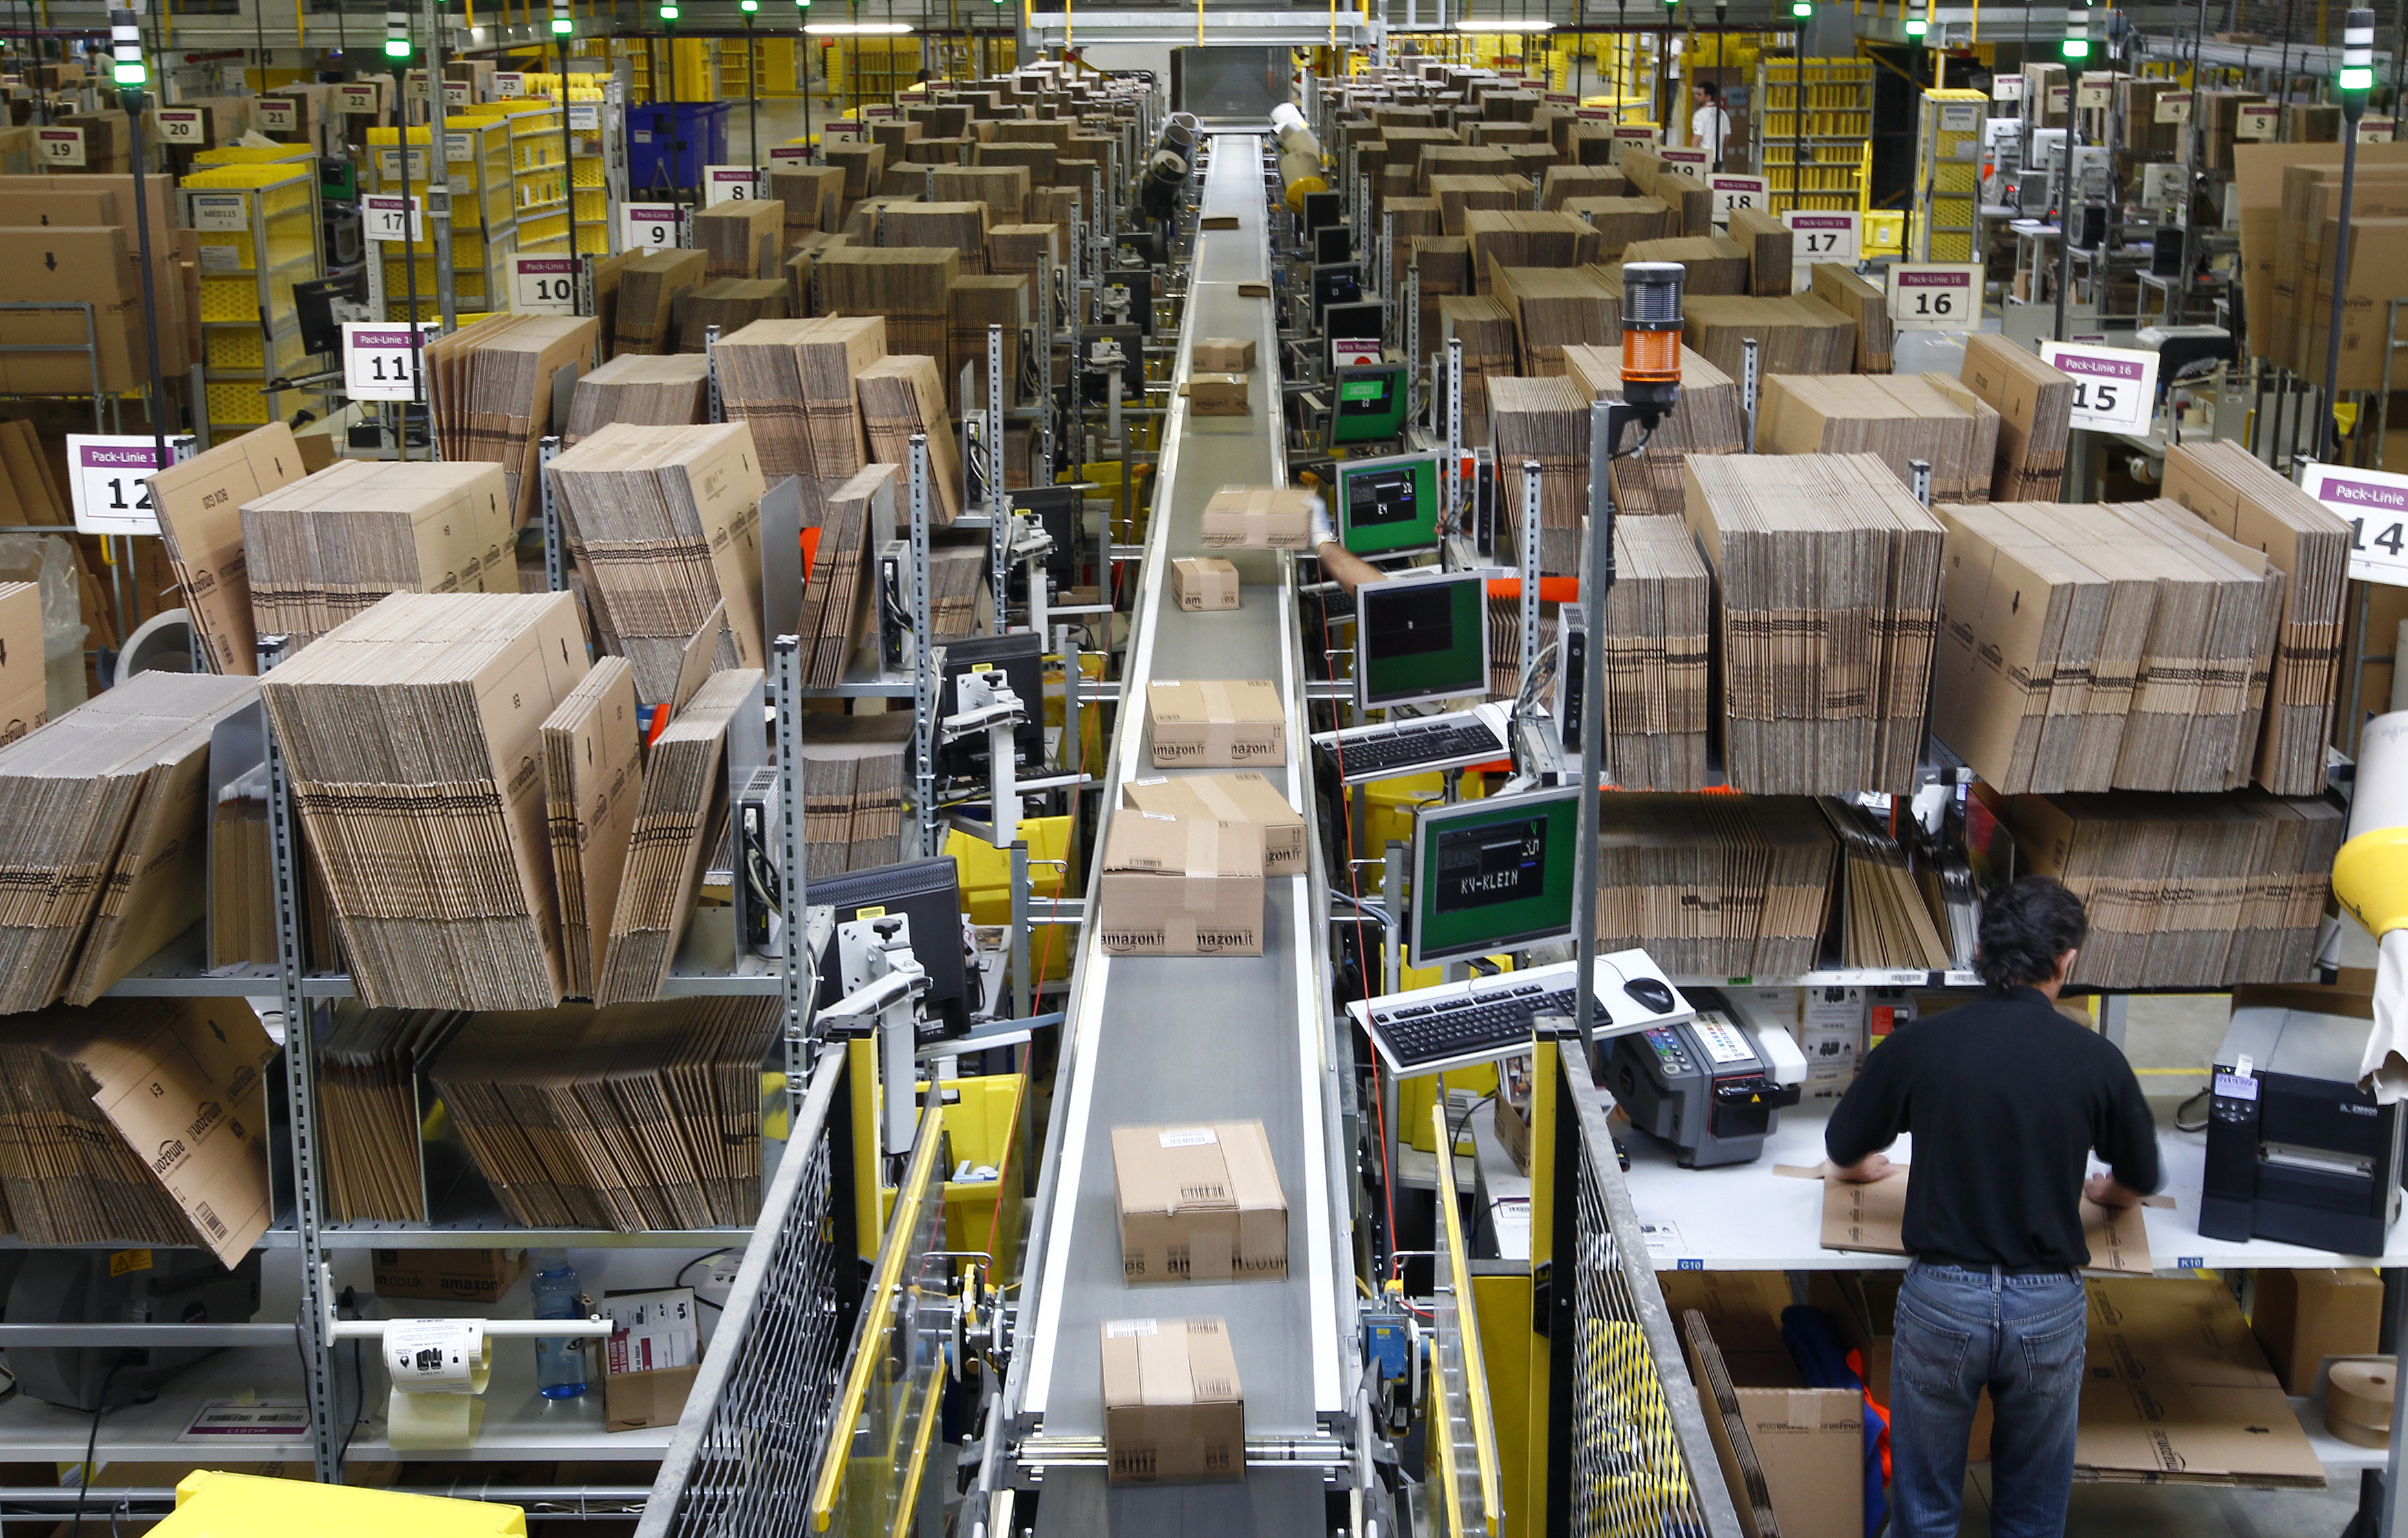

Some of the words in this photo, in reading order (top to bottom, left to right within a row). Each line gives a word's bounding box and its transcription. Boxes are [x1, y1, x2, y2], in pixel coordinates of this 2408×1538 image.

[504, 82, 515, 90] 25
[351, 96, 365, 106] 22
[449, 91, 462, 100] 24
[269, 113, 284, 123] 21
[2256, 118, 2266, 129] 5
[171, 124, 189, 135] 20
[52, 144, 70, 155] 19
[732, 186, 744, 200] 8
[1726, 195, 1752, 209] 18
[383, 214, 404, 230] 17
[652, 226, 665, 243] 9
[1807, 234, 1837, 252] 17
[527, 262, 564, 272] Pack-Linie
[1908, 275, 1947, 285] Pack-Linie
[1951, 275, 1961, 284] 16
[537, 279, 570, 300] 10
[1915, 293, 1953, 316] 16
[360, 335, 402, 345] Pack-Linie
[372, 356, 409, 380] 11
[2065, 359, 2117, 374] Pack-Linie
[2120, 364, 2133, 376] 16
[2073, 382, 2118, 411] 15
[92, 451, 147, 463] Pack-Linie
[108, 478, 153, 509] 12
[2336, 484, 2405, 506] Pack-Linie
[2352, 517, 2405, 556] 14
[1461, 869, 1518, 894] KV-KLEIN
[1681, 1261, 1701, 1270] G10
